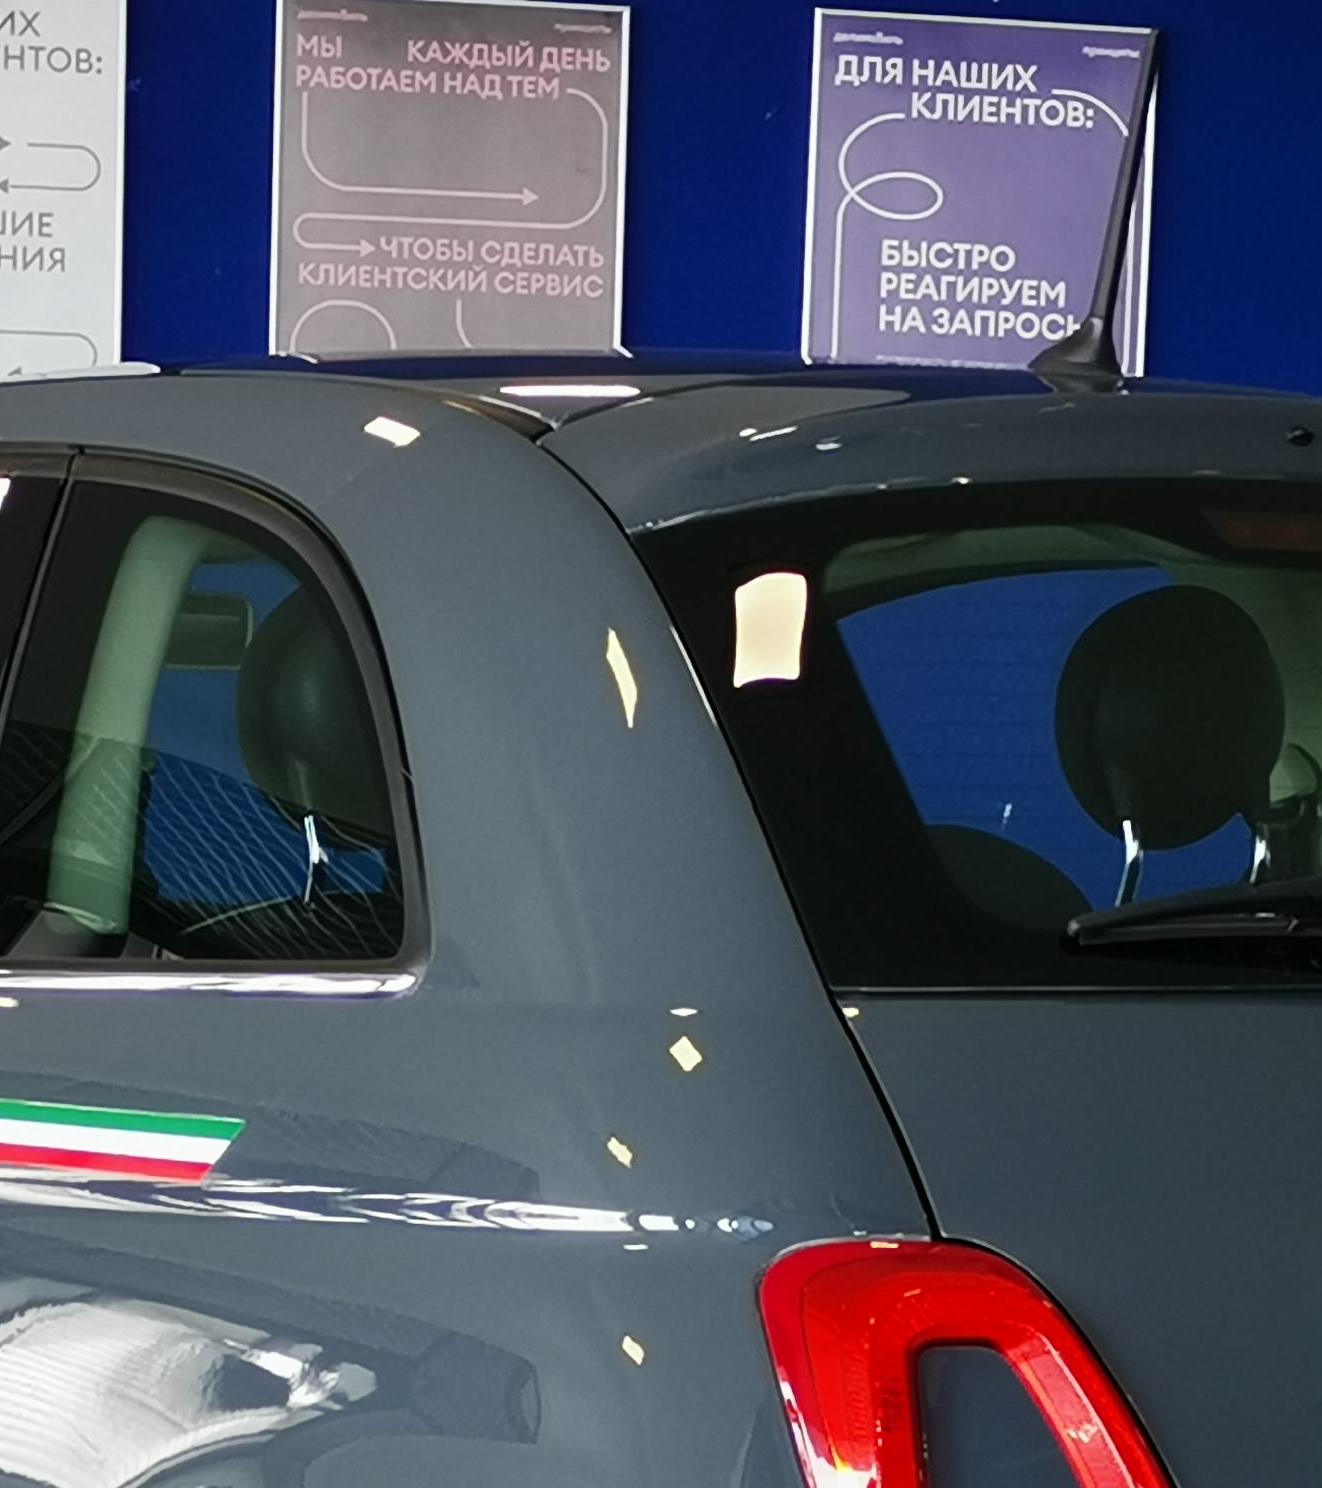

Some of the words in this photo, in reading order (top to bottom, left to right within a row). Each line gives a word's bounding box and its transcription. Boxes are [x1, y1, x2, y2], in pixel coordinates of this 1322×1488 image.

[296, 34, 342, 60] МЫ
[407, 40, 534, 70] КАЖДЫЙ
[539, 46, 612, 73] ДЕНЬ
[295, 64, 437, 94] РАБОТАЕМ
[443, 71, 503, 100] НАД
[507, 75, 560, 99] ТЕМ
[834, 55, 904, 87] ДЛЯ
[912, 59, 1038, 92] НАШИХ
[911, 92, 1094, 129] КЛИЕНТОВ:
[379, 236, 474, 263] ЧТОБЫ
[480, 240, 605, 268] СДЕЛАТЬ
[881, 239, 1016, 272] БЫСТРО
[298, 262, 487, 293] КЛИЕНТСКИЙ
[494, 271, 604, 298] СЕРВИС
[880, 273, 1066, 307] РЕАГИРУЕМ
[879, 304, 926, 334] НА
